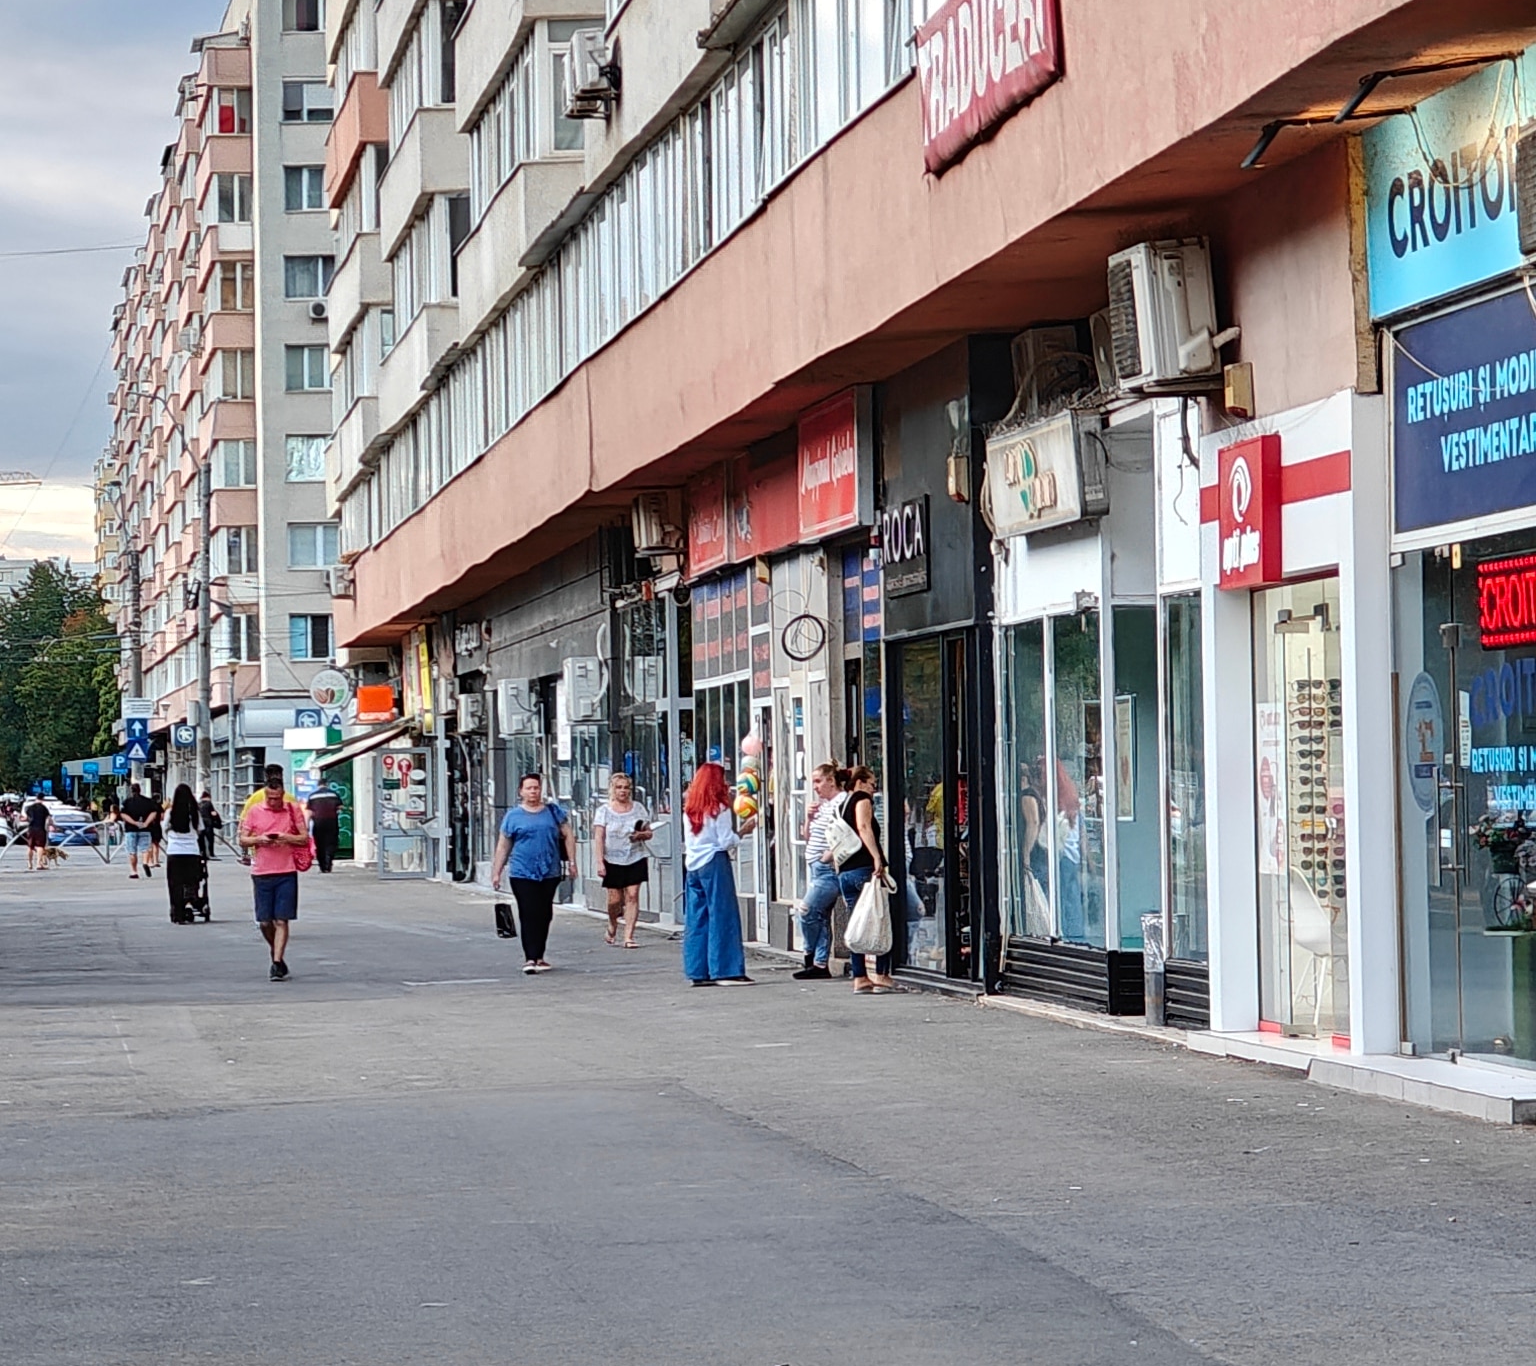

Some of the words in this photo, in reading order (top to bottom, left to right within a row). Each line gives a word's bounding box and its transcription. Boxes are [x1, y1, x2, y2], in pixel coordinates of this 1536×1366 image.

[1407, 368, 1474, 424] RETUȘURI
[1478, 363, 1491, 413] ȘI
[1495, 349, 1536, 401] MODI
[882, 502, 924, 564] ROCA
